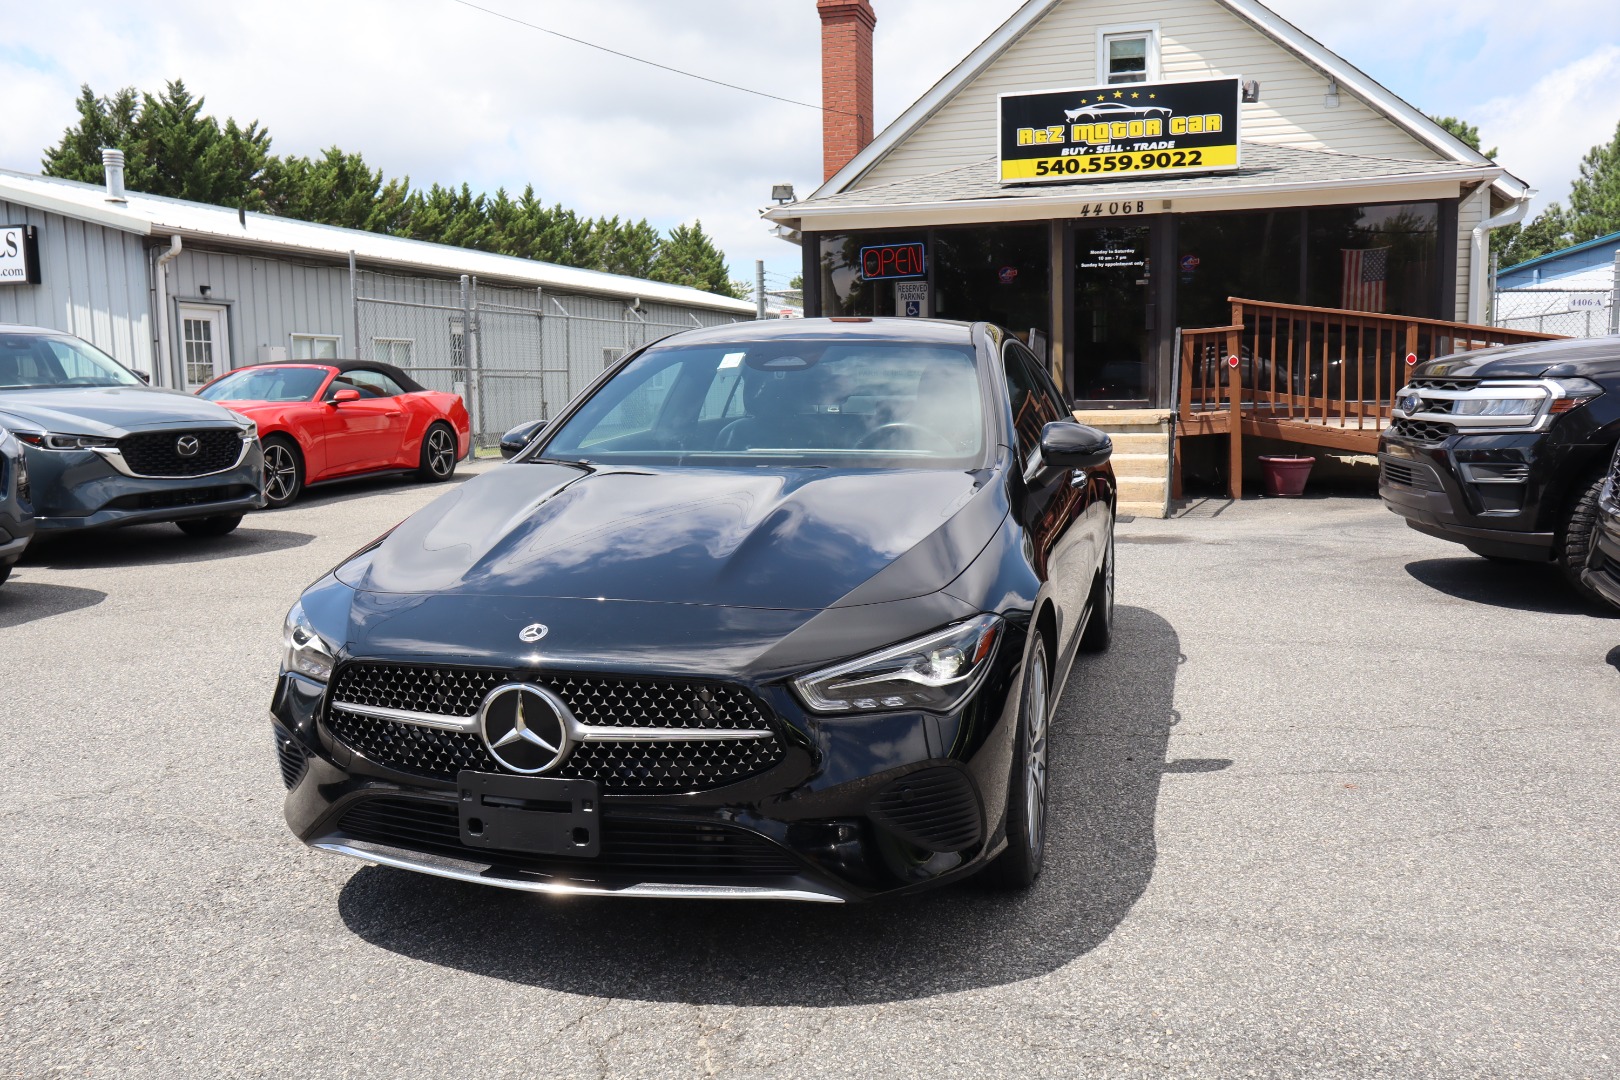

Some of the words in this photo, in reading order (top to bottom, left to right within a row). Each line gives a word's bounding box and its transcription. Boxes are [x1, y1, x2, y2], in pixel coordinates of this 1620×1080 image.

[1017, 125, 1065, 146] R&Z
[1061, 147, 1088, 156] BUY
[1095, 144, 1124, 154] SELL
[1133, 140, 1175, 151] TRADE
[1036, 150, 1202, 176] 540.559.9022
[0, 231, 18, 258] S
[864, 246, 922, 277] OPEN
[897, 284, 928, 293] RESERVED
[900, 292, 926, 301] PARKING
